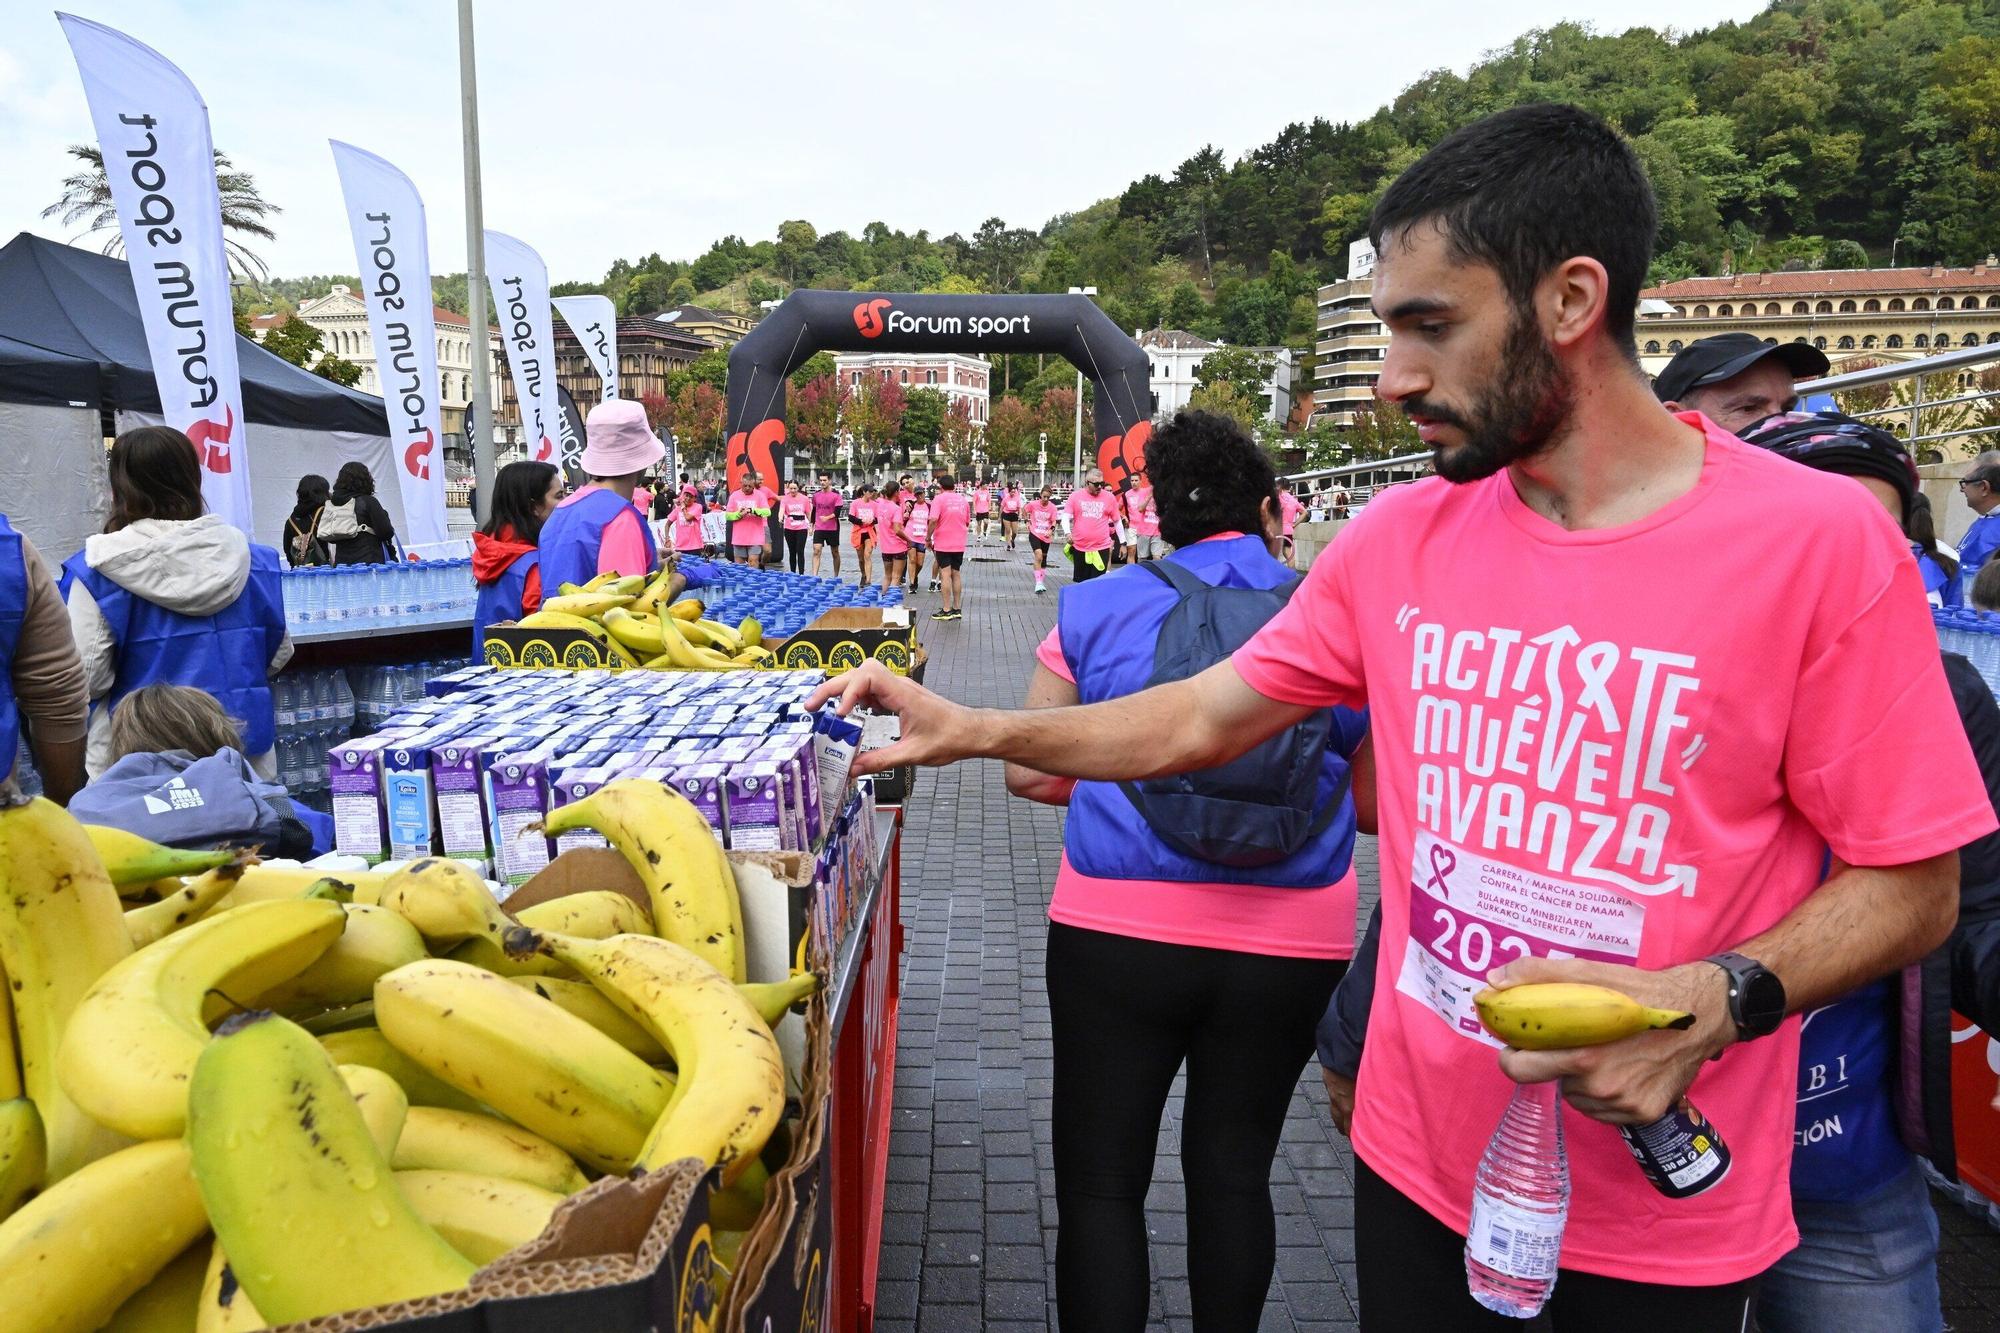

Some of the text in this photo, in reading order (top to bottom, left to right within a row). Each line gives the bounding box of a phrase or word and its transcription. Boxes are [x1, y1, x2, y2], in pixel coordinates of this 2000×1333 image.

[888, 311, 1030, 338] Forum sport
[1480, 875, 1625, 918] CONTRA EL CÁNCER DE MAMA
[1482, 864, 1523, 882] CARRERA
[1532, 879, 1576, 898] MARCHA
[1578, 890, 1633, 907] SOLIDARIA
[1477, 901, 1520, 920] AURKAKO
[1522, 914, 1576, 936] LASTERKETA
[1586, 932, 1630, 946] MARTXA
[1478, 890, 1528, 913] BULARREKO
[1530, 907, 1593, 929] MINBIZIAREN
